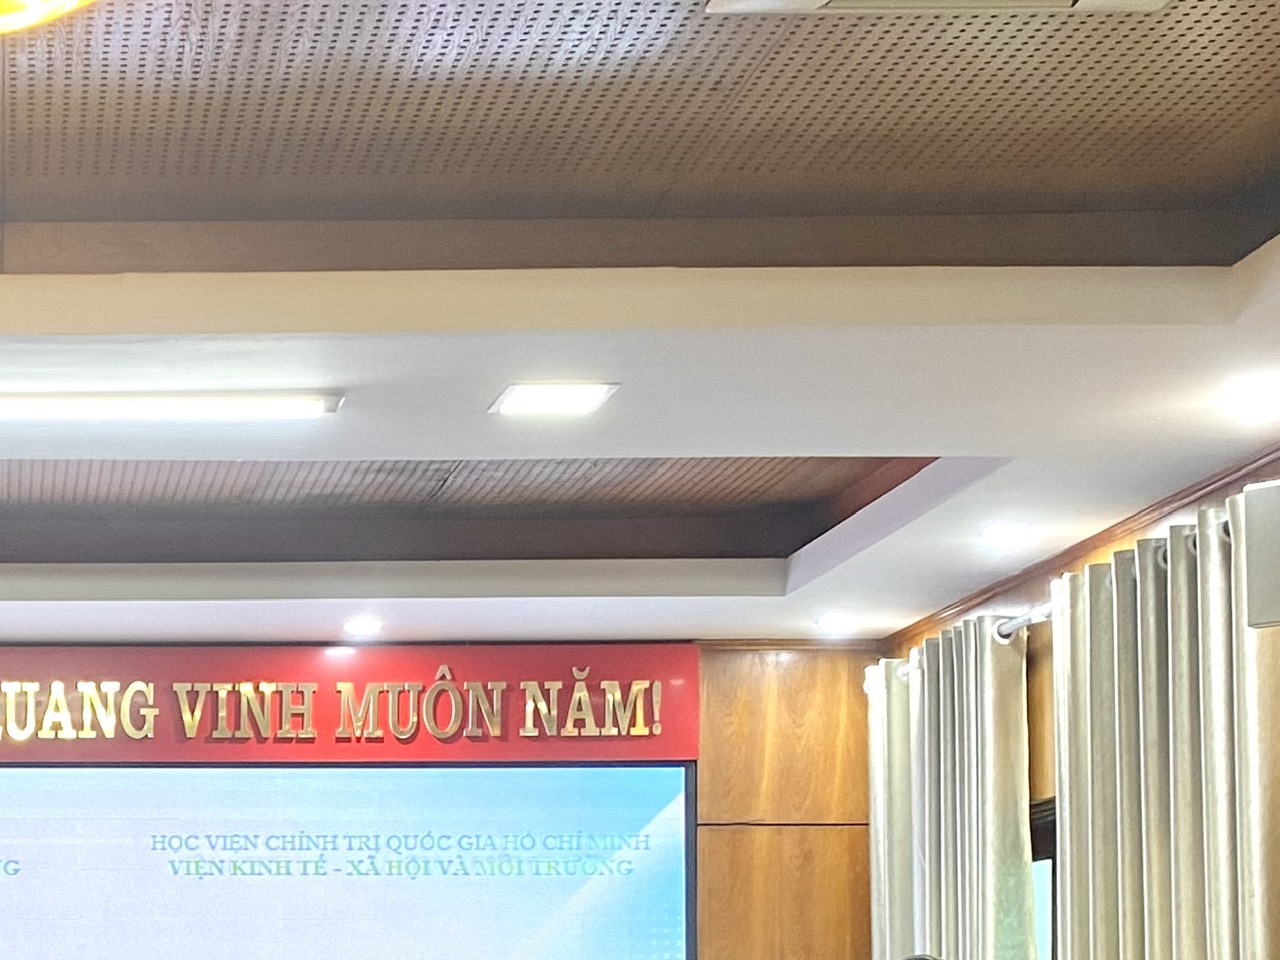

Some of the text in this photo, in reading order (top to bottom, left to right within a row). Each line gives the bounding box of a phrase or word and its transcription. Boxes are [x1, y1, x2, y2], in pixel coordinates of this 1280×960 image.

[172, 681, 318, 741] VINH
[335, 665, 506, 741] MUÔN
[520, 665, 664, 740] NĂM!
[150, 830, 651, 853] HỌC VIỆN CHÍNH TRỊ QUỐC GIA HỒ CHÍ MINH
[167, 856, 225, 880] VIỆN
[230, 859, 293, 876] KINH
[297, 854, 328, 876] TẾ
[346, 855, 382, 876] XÃ
[385, 857, 432, 880] HỘI
[436, 855, 470, 876] VÀ
[474, 854, 525, 876] MÔI
[528, 856, 635, 876] TRƯỜNG
